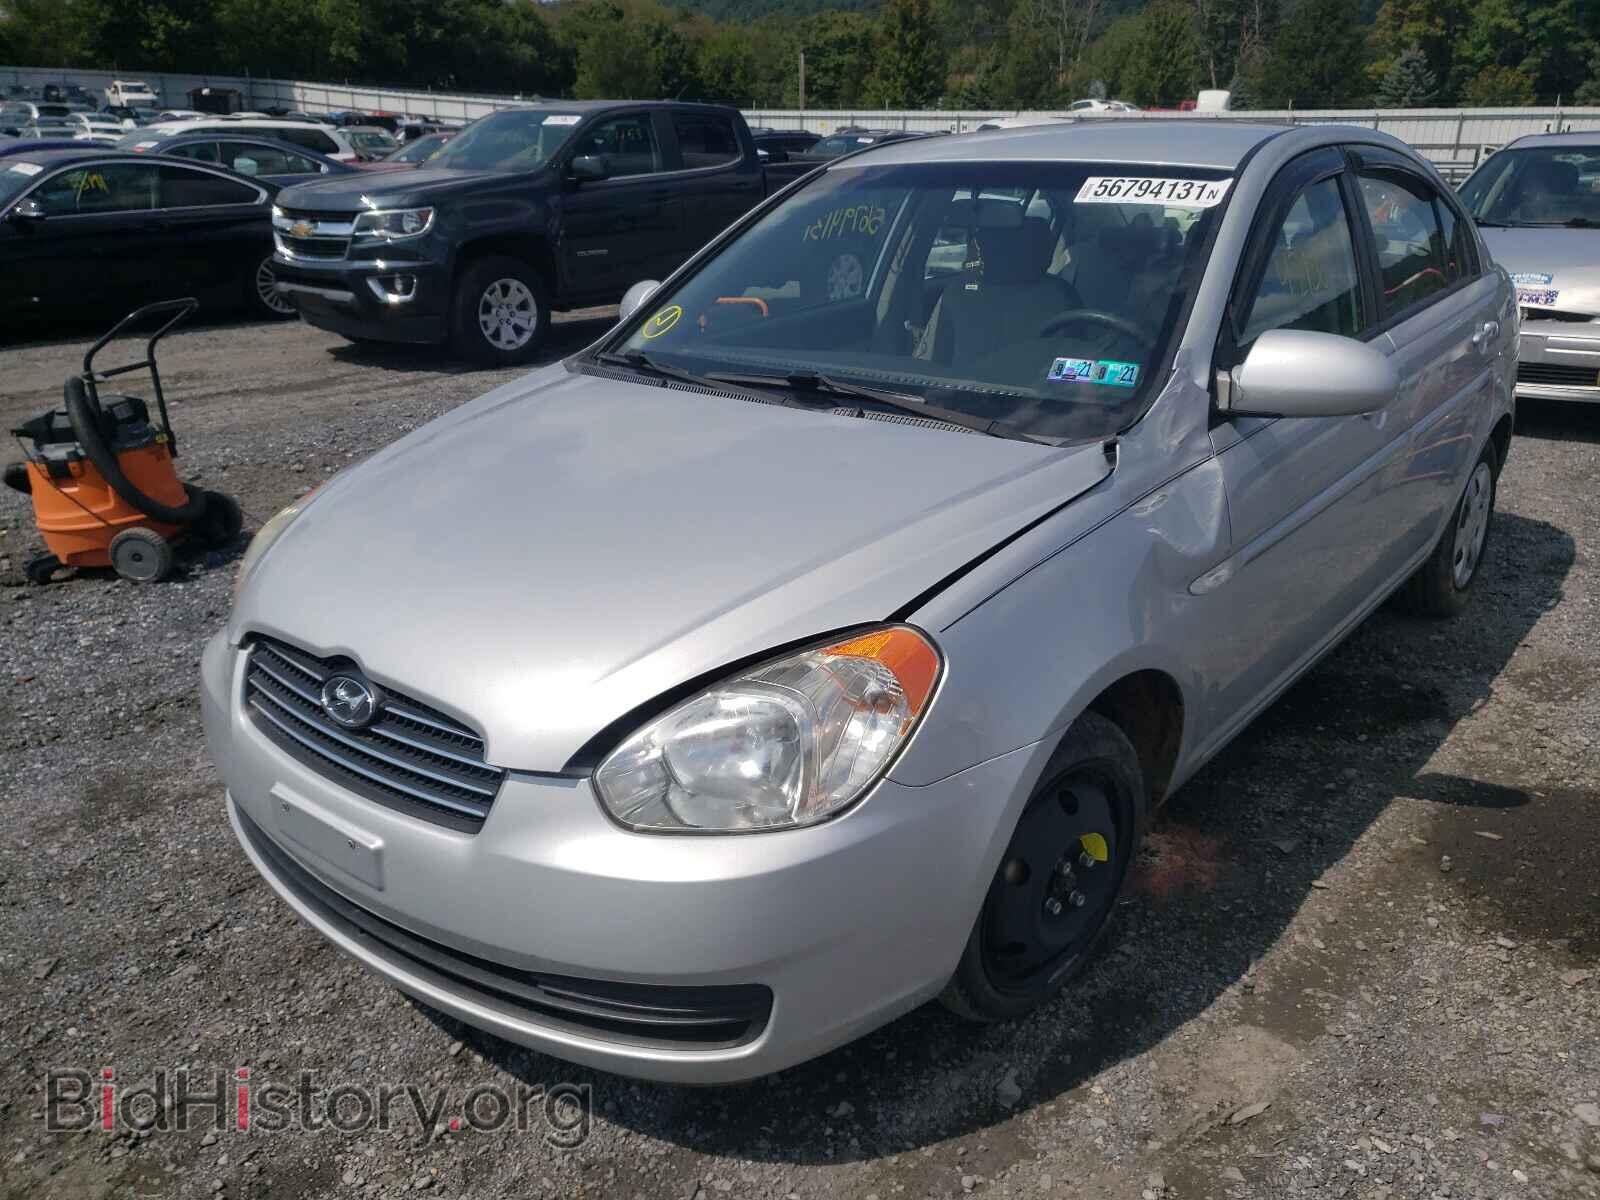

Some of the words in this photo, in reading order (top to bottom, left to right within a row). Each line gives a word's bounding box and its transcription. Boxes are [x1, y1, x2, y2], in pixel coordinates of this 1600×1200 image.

[1094, 179, 1207, 200] 56794131
[1207, 189, 1219, 199] N
[1120, 366, 1135, 382] 21
